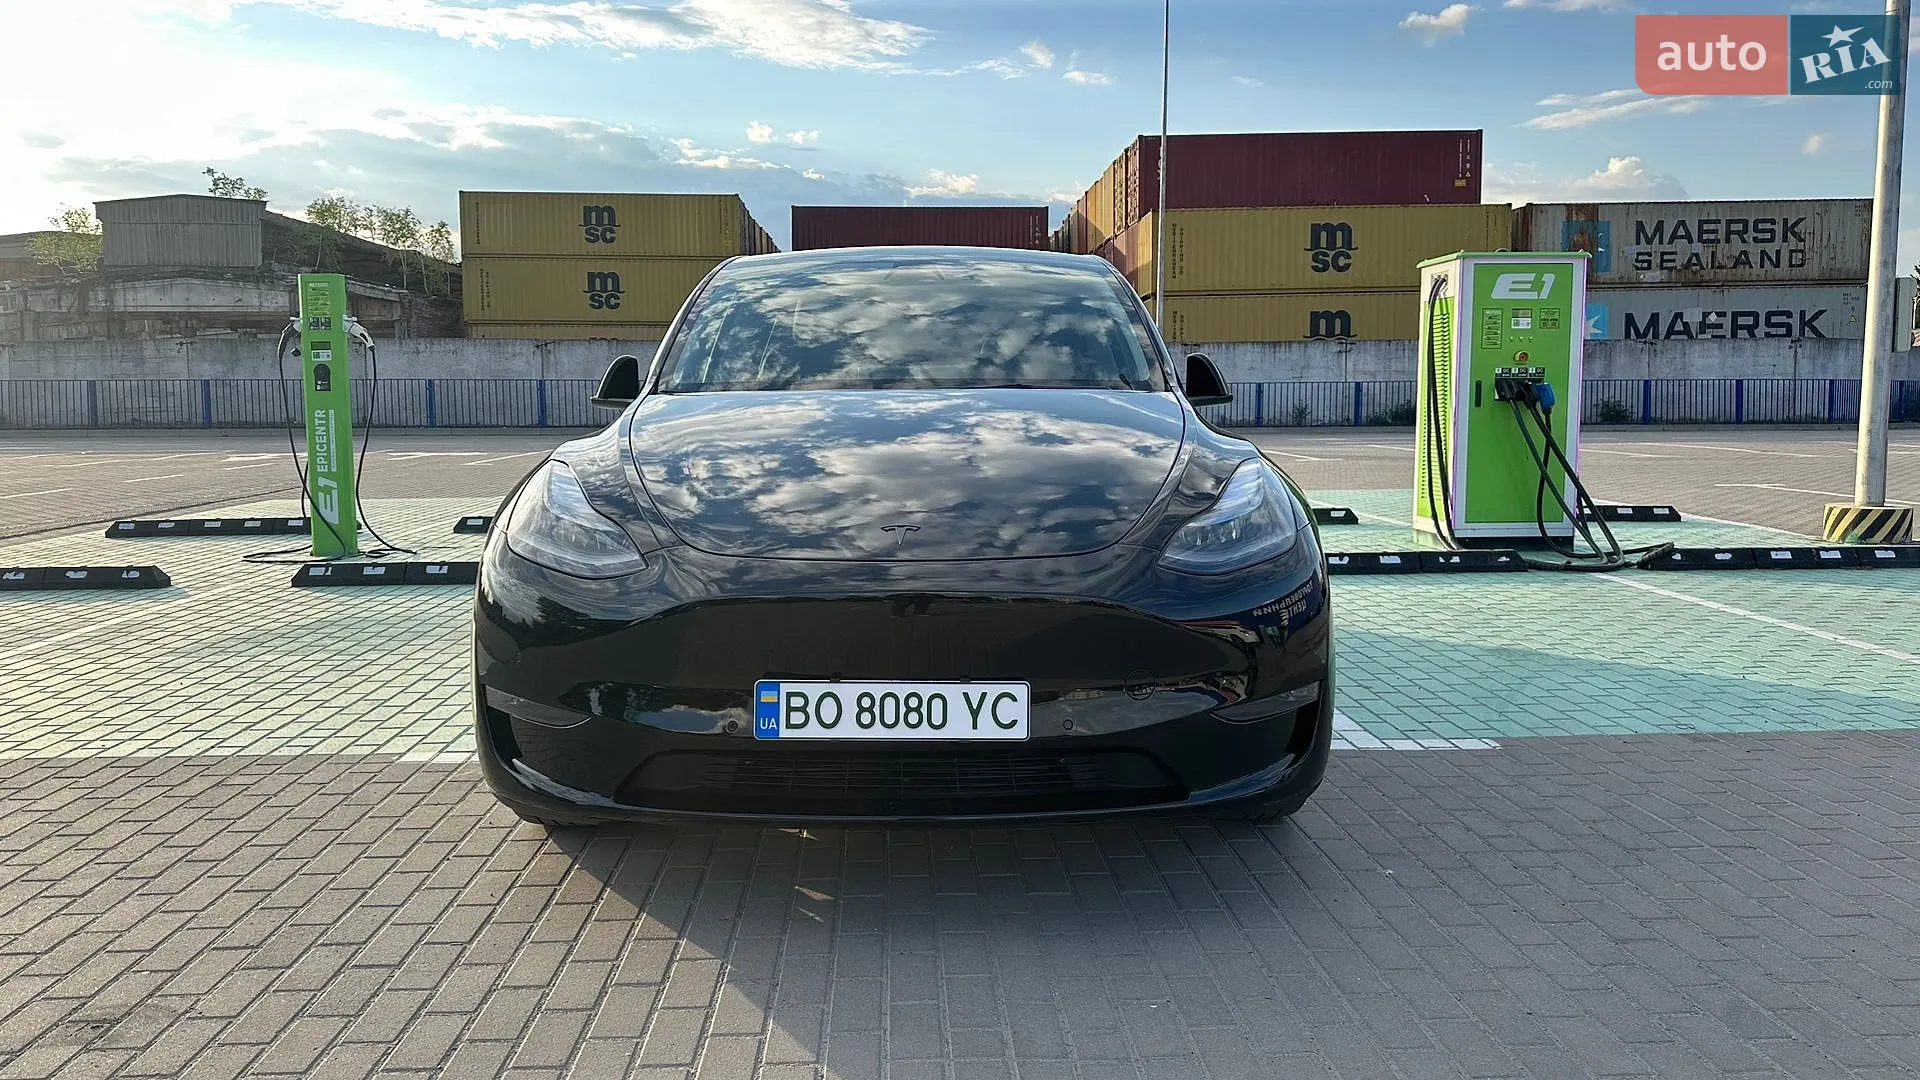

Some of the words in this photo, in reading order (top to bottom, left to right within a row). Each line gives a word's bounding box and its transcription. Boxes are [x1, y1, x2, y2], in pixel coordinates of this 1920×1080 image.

[1635, 217, 1807, 246] MAERSK
[1634, 249, 1807, 271] SEALAND
[1624, 308, 1828, 339] MAERSK
[315, 409, 329, 472] EPICENTR
[759, 717, 778, 730] UA
[785, 691, 843, 730] BO
[855, 691, 948, 730] 8080
[962, 691, 1019, 730] YC
